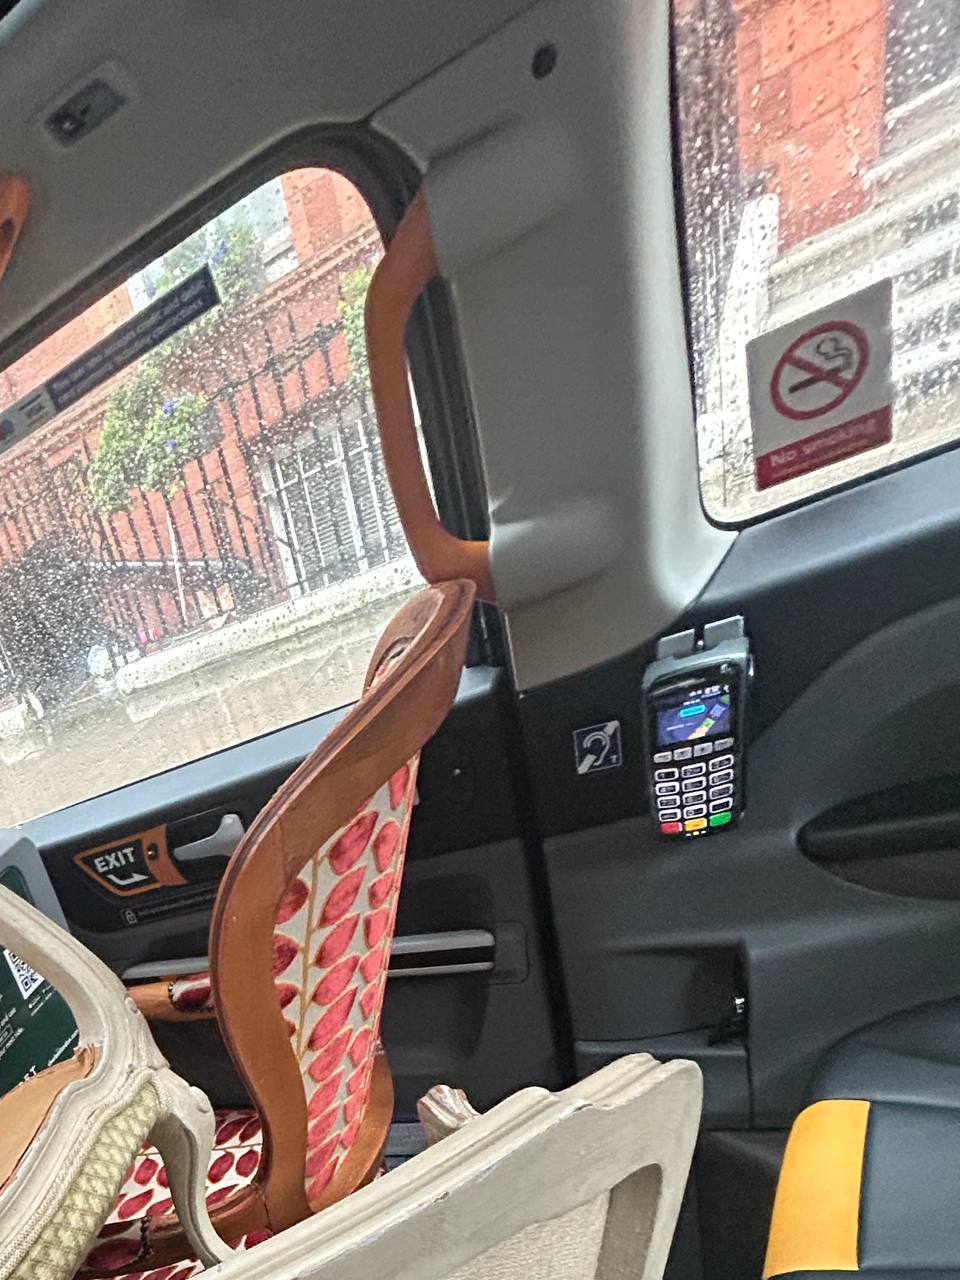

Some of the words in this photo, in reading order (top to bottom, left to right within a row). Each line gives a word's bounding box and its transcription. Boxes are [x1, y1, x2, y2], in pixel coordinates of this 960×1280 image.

[770, 447, 797, 467] No
[802, 417, 879, 455] smoking
[93, 847, 136, 873] EXIT
